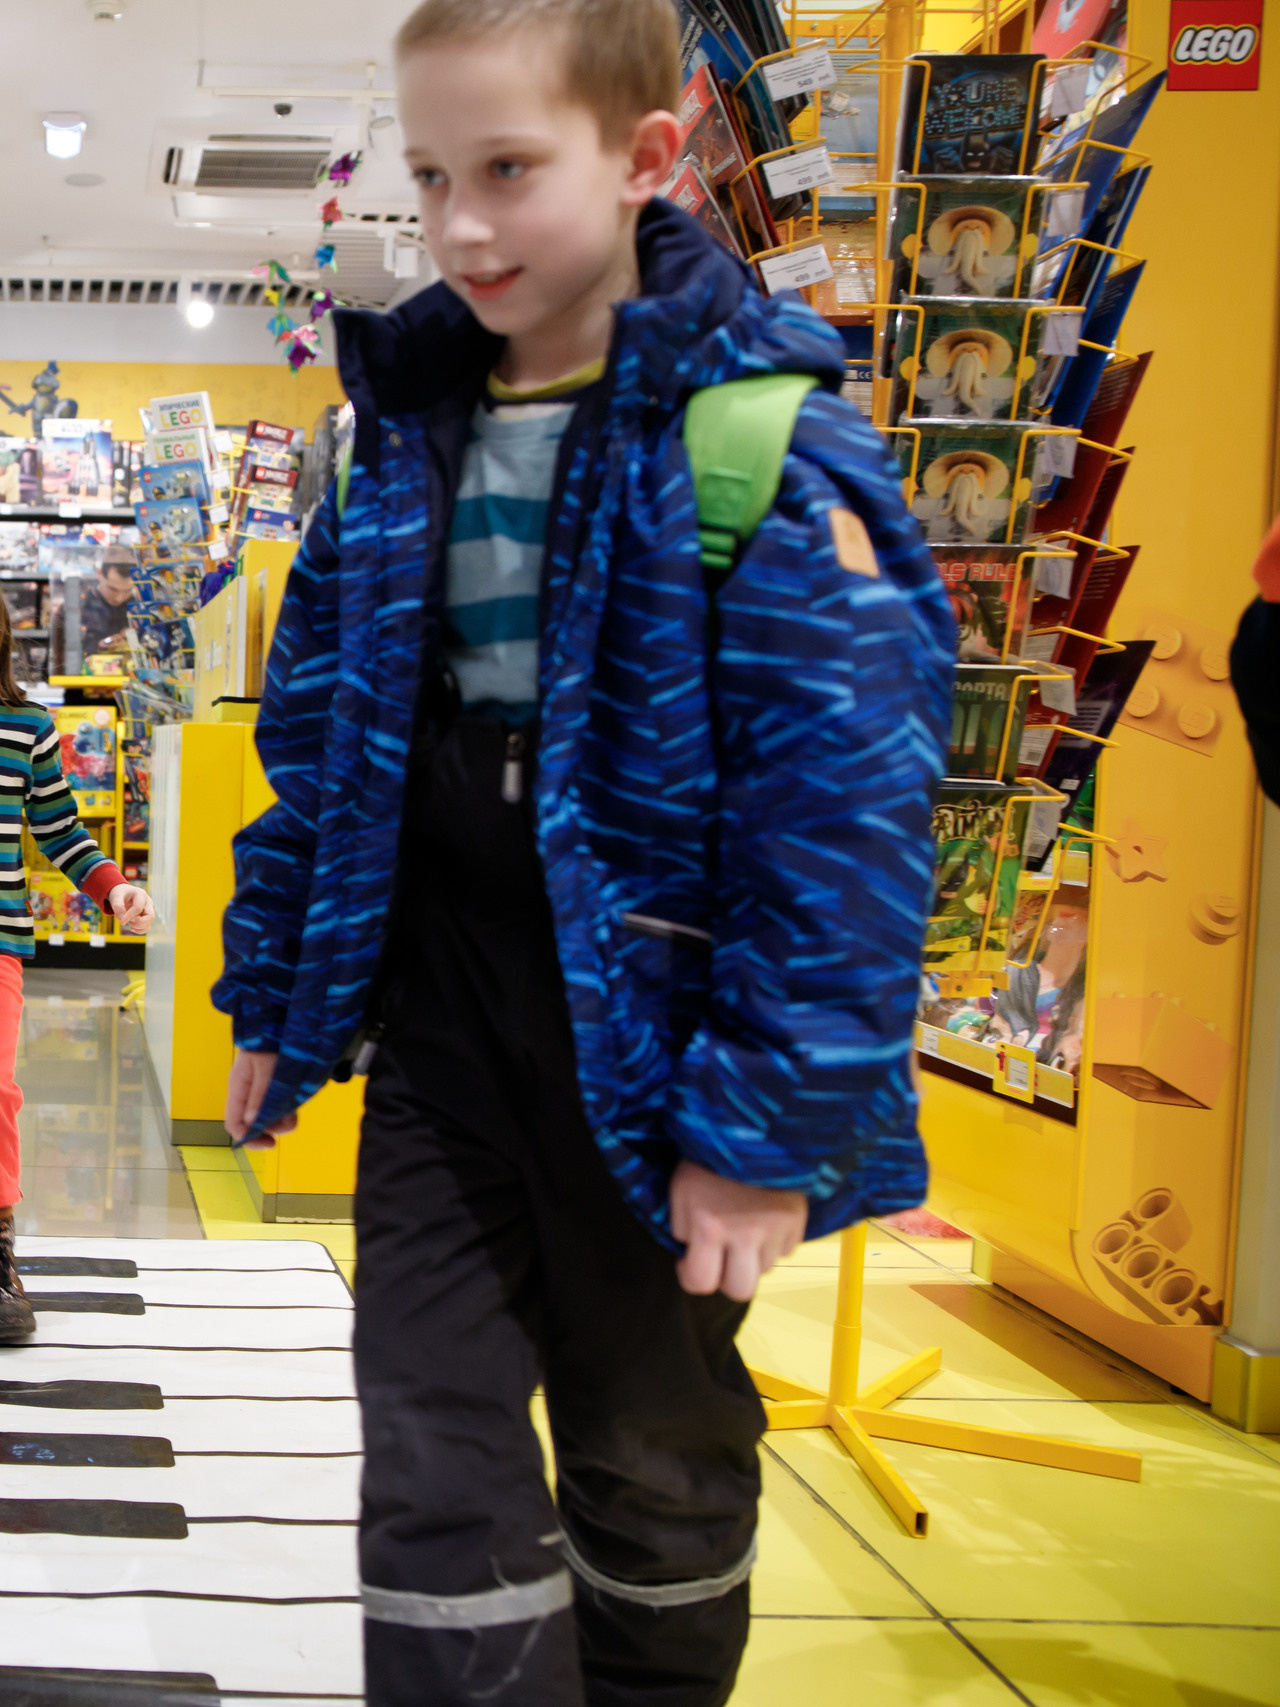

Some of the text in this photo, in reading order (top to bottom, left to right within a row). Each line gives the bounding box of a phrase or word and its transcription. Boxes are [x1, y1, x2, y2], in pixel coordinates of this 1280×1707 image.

[1173, 26, 1257, 63] LEGO
[797, 78, 813, 88] 549
[160, 408, 202, 428] LEGO
[154, 442, 197, 460] LEGO
